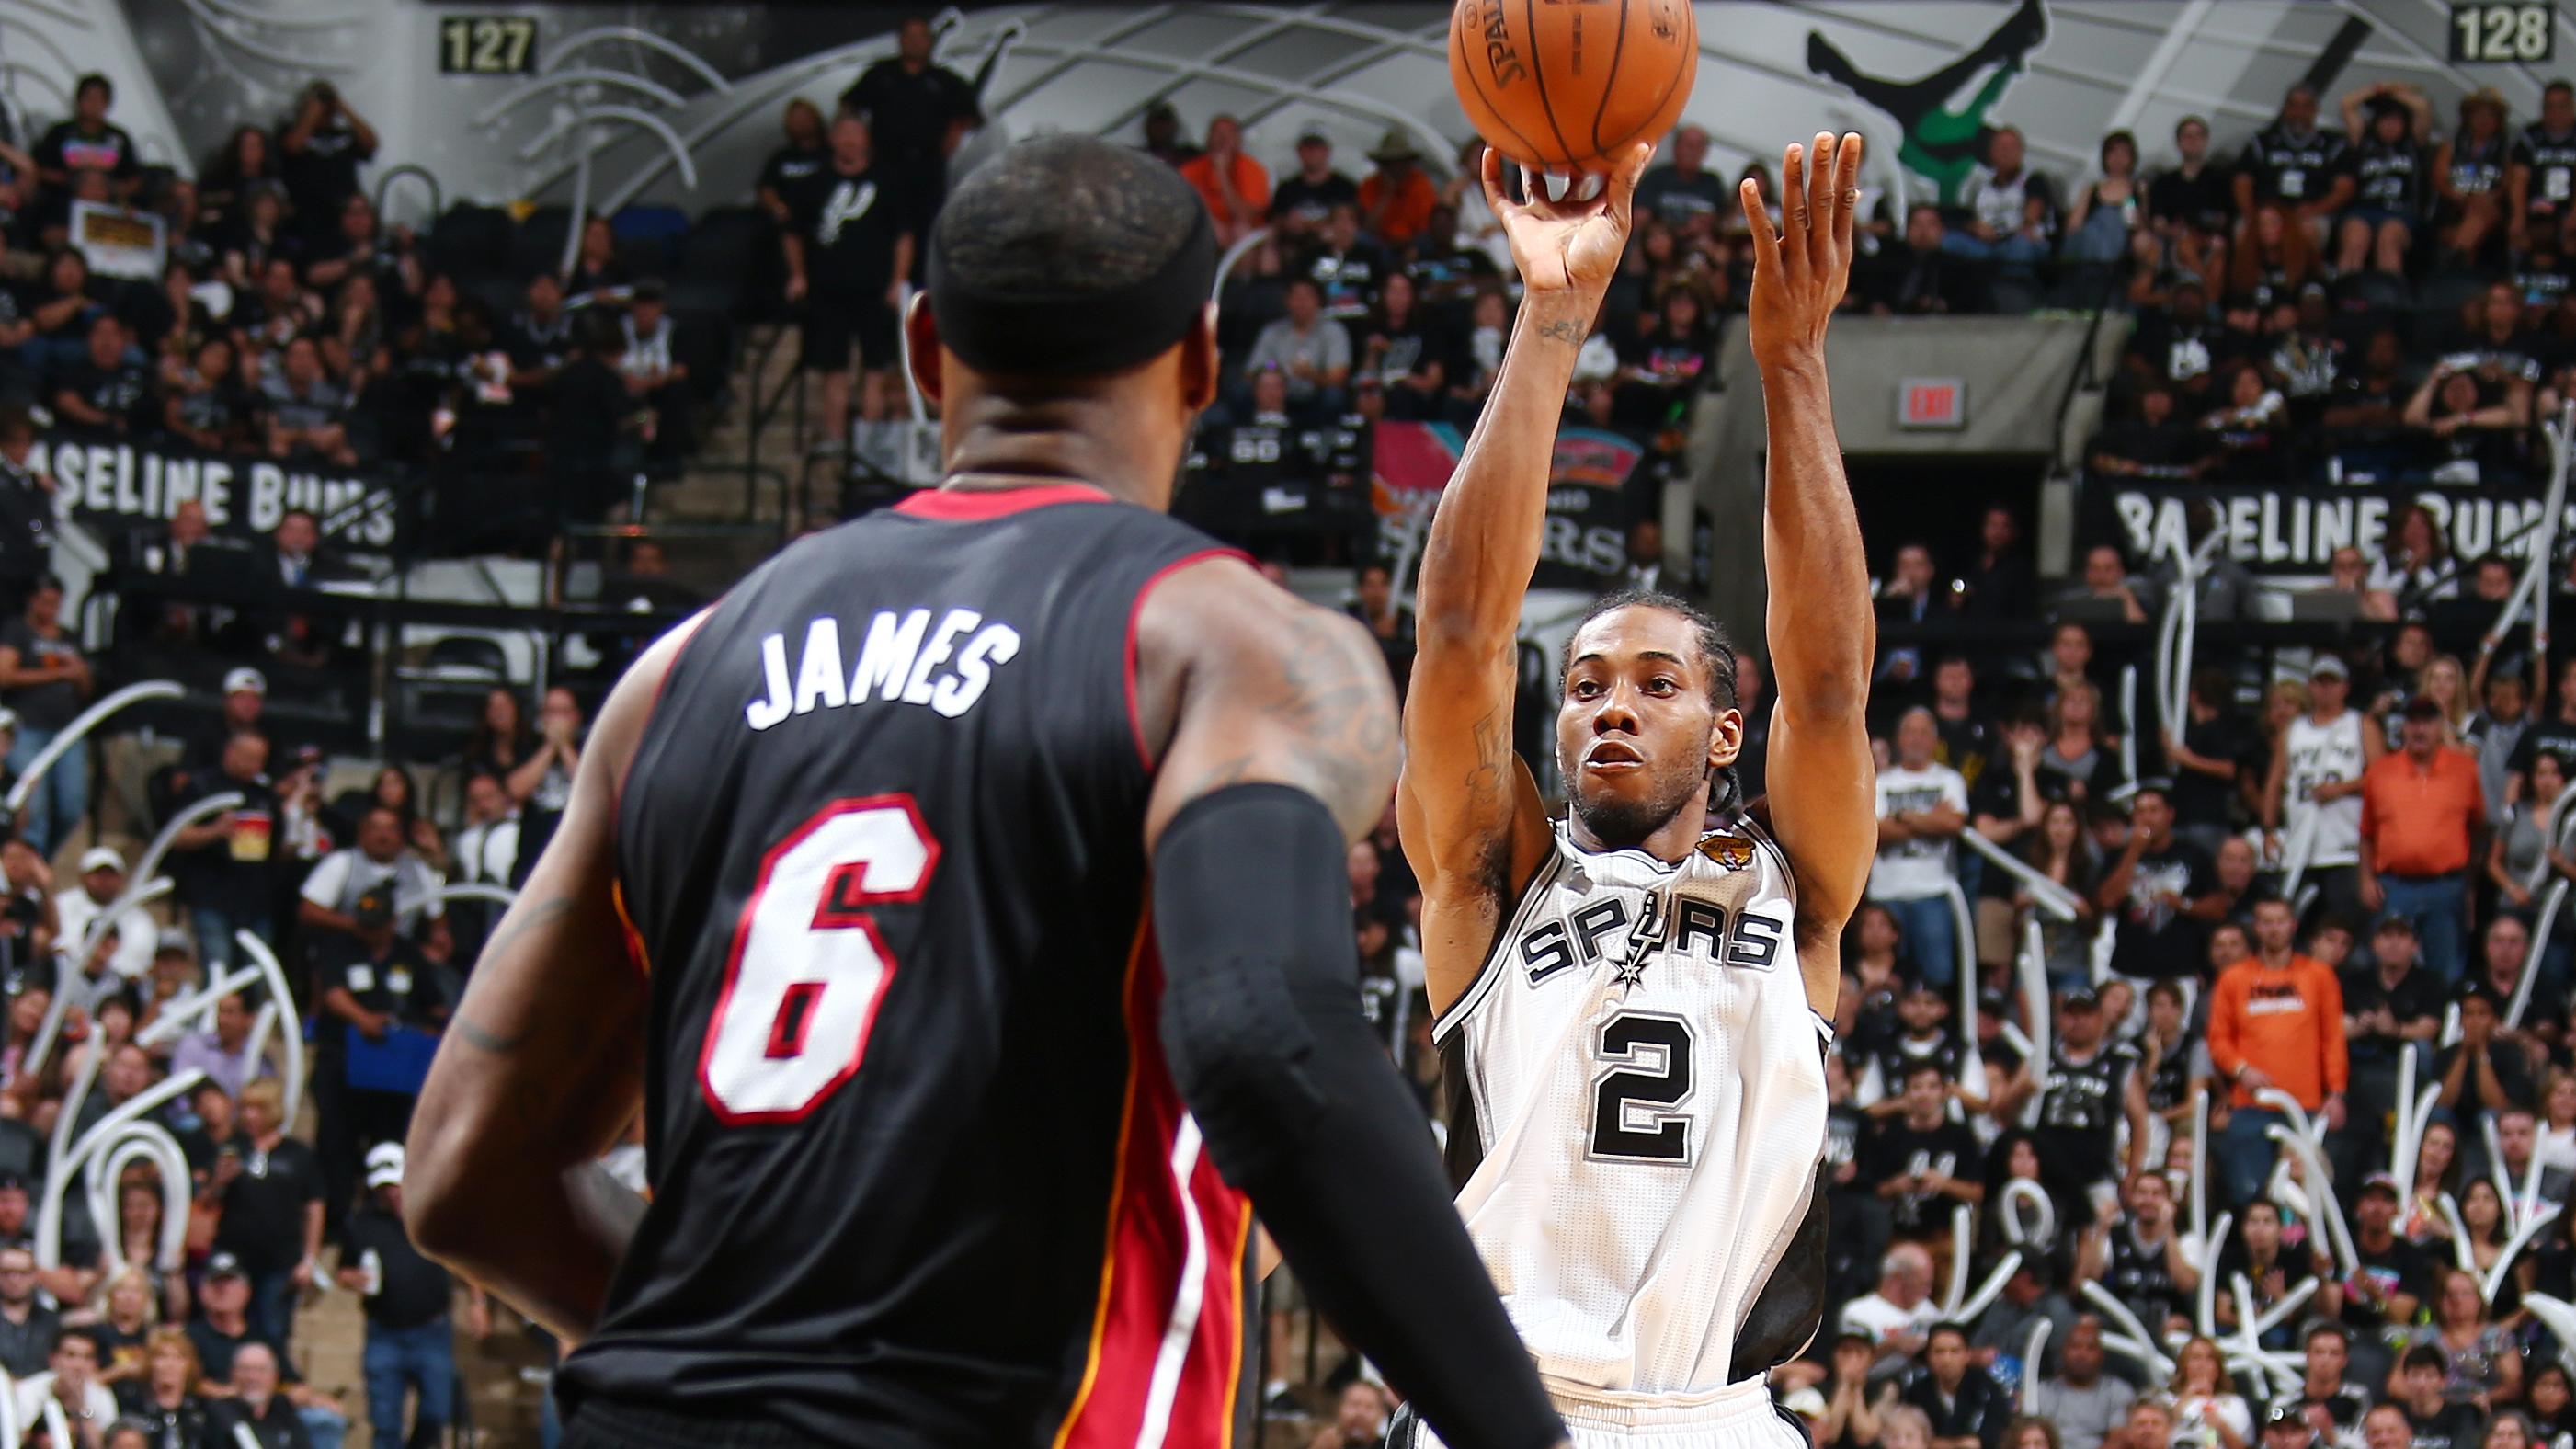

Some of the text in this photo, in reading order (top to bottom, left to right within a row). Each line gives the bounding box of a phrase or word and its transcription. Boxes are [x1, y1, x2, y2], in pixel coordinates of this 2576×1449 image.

[445, 22, 531, 70] 127
[2457, 6, 2549, 60] 128
[1909, 386, 1954, 419] EXIT
[26, 441, 234, 525] ASELINE
[2116, 491, 2389, 564] BAELINE
[746, 608, 1020, 732] JAMES
[697, 792, 941, 1126] 6
[1519, 888, 1785, 991] SPURS
[1583, 1009, 1697, 1169] 2
